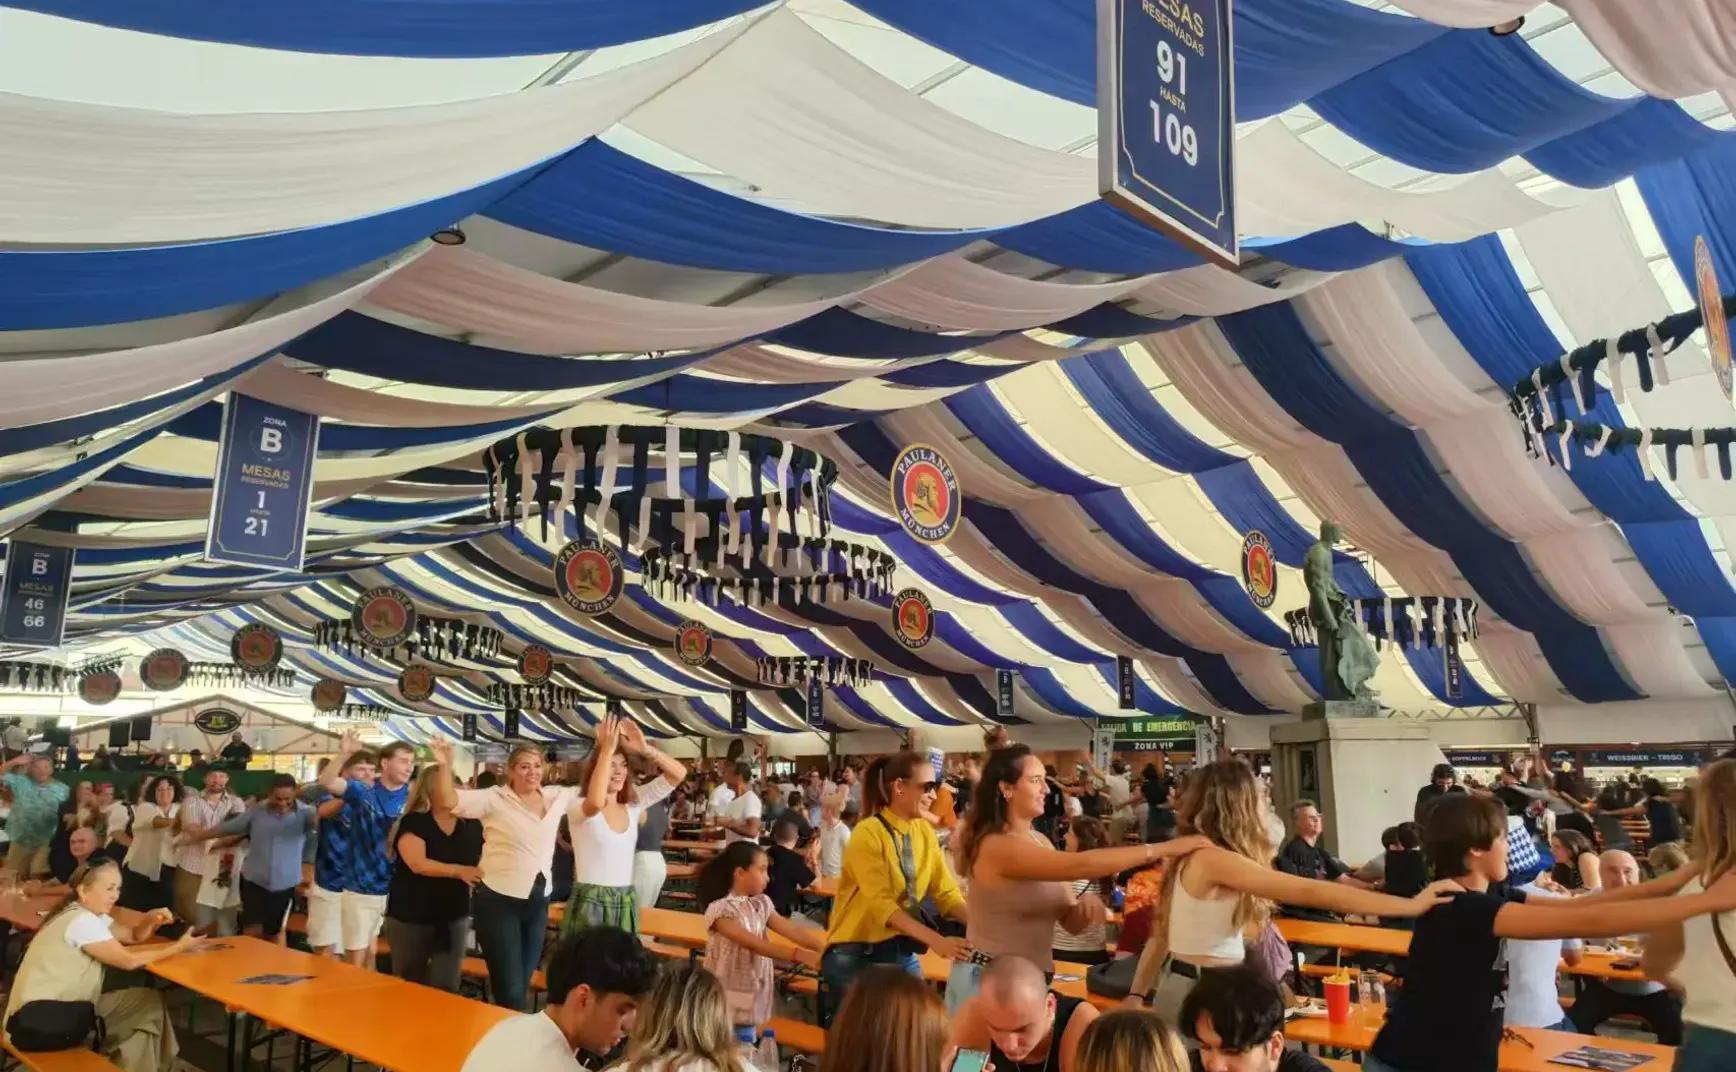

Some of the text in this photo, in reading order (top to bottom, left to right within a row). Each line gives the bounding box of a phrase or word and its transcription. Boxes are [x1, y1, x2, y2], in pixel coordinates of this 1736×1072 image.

[1142, 0, 1205, 57] RESERVADAS
[1157, 40, 1186, 95] 91
[1160, 85, 1186, 114] HASTA
[1150, 99, 1198, 167] 109
[263, 416, 287, 428] ZONA
[261, 427, 282, 453] B
[241, 463, 291, 482] MESAS
[897, 449, 956, 492] PAULANER
[257, 491, 266, 509] 1
[244, 516, 269, 537] 21
[32, 558, 48, 575] B
[25, 597, 45, 610] 46
[1132, 722, 1143, 733] DE
[1134, 741, 1174, 750] ZONA VIP
